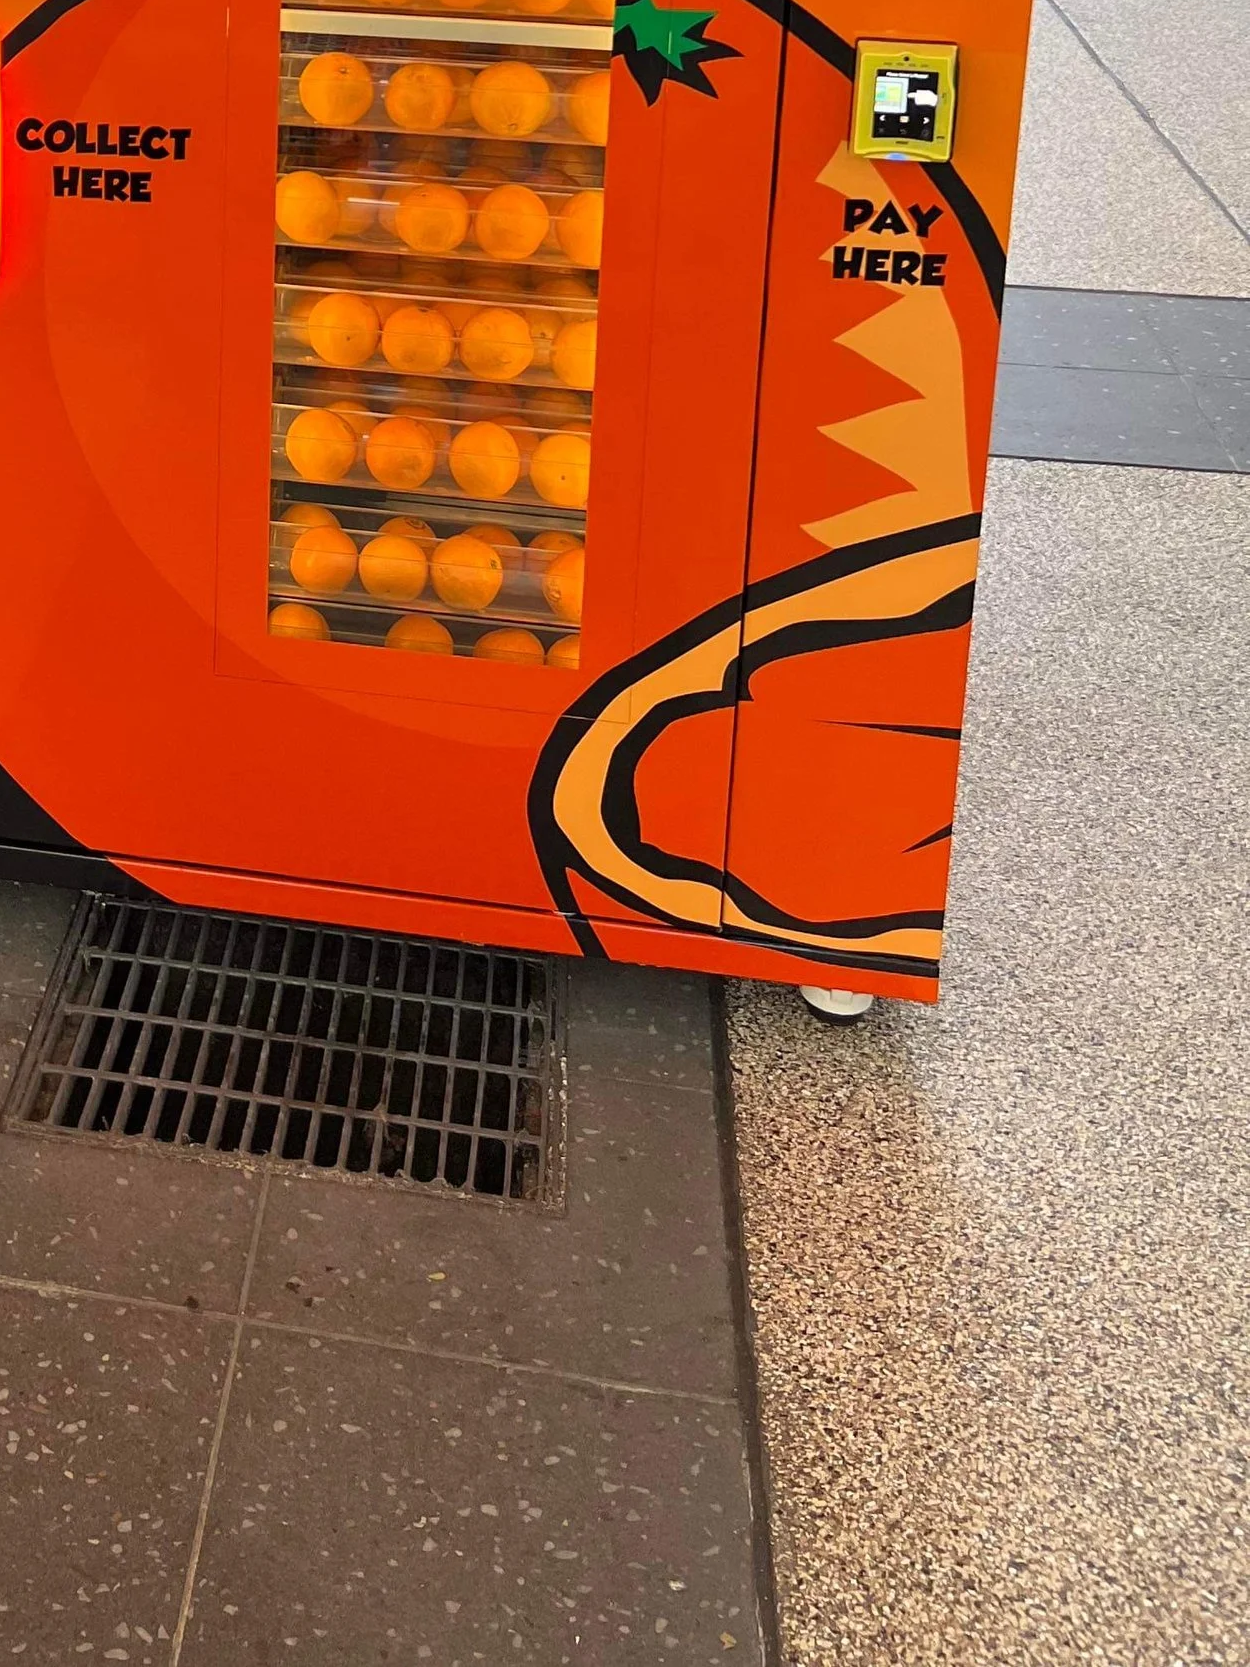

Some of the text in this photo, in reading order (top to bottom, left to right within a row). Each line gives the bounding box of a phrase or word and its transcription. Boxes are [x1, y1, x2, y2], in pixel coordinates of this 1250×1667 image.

[15, 117, 192, 161] COLLECT
[52, 166, 153, 203] HERE
[843, 197, 944, 239] PAY
[831, 245, 948, 288] HERE
